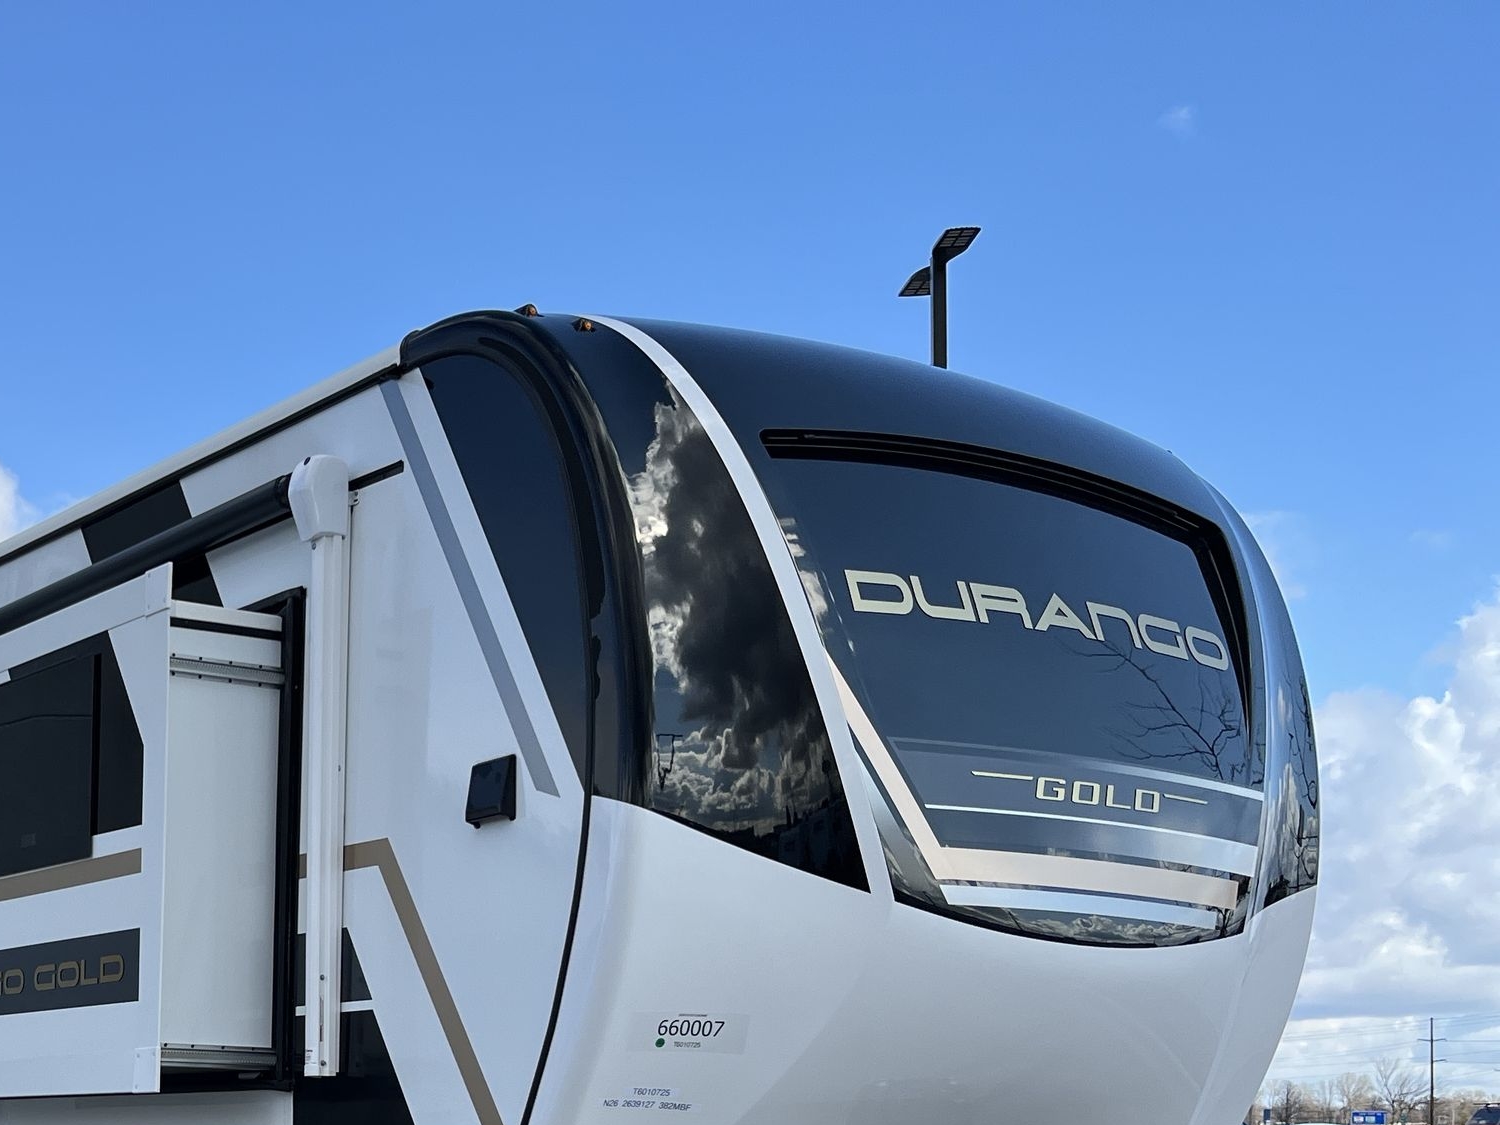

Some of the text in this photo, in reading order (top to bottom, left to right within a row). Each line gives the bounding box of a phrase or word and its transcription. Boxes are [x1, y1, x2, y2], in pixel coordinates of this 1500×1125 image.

[844, 569, 1230, 671] DURANGO
[1035, 777, 1160, 813] GOLD
[34, 954, 124, 992] GOLD
[657, 1019, 725, 1037] 660007
[633, 1087, 671, 1096] T6010725
